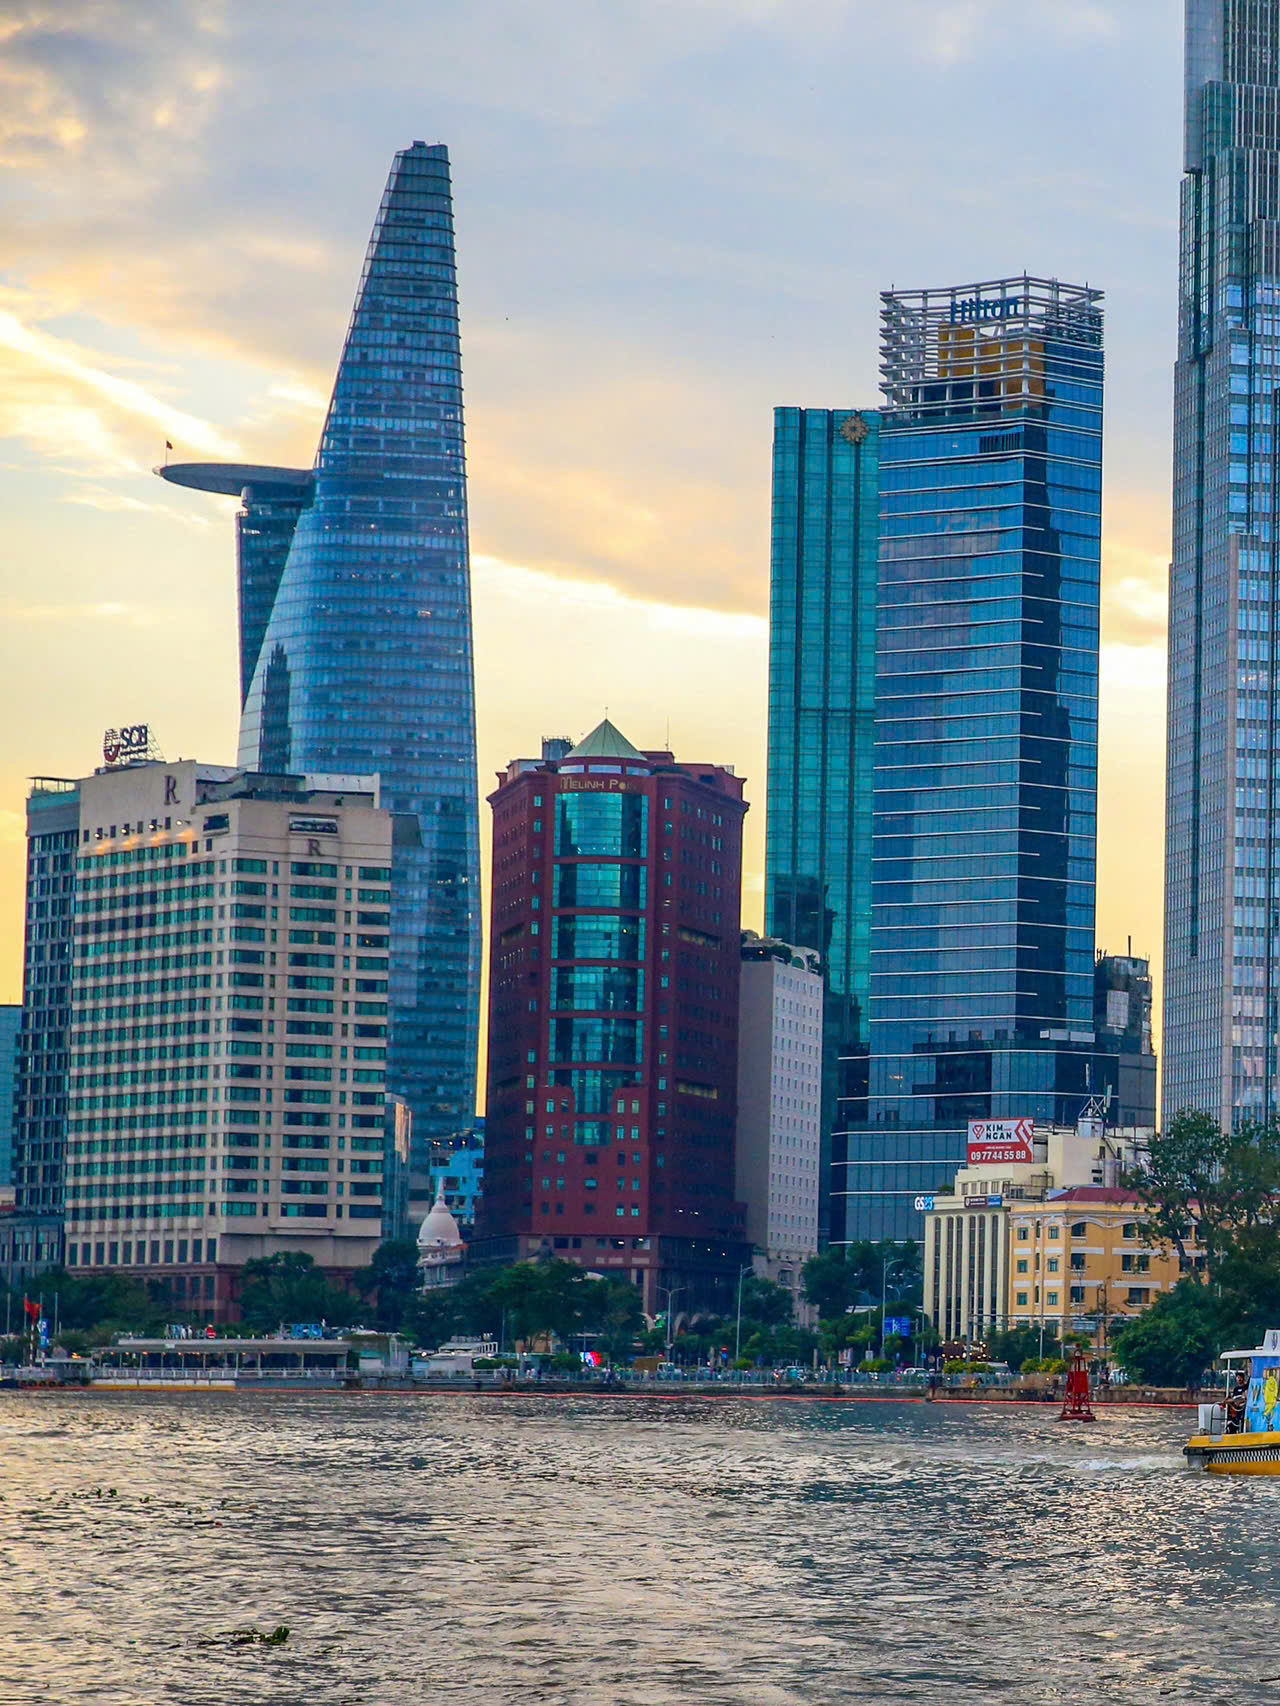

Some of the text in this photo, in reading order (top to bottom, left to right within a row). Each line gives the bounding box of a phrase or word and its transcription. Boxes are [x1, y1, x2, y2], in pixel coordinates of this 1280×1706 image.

[951, 297, 1019, 324] Hilton
[120, 725, 148, 748] SCB
[164, 775, 181, 806] R
[307, 838, 322, 856] R
[986, 1124, 1003, 1132] KIM
[986, 1132, 1013, 1140] NGAN
